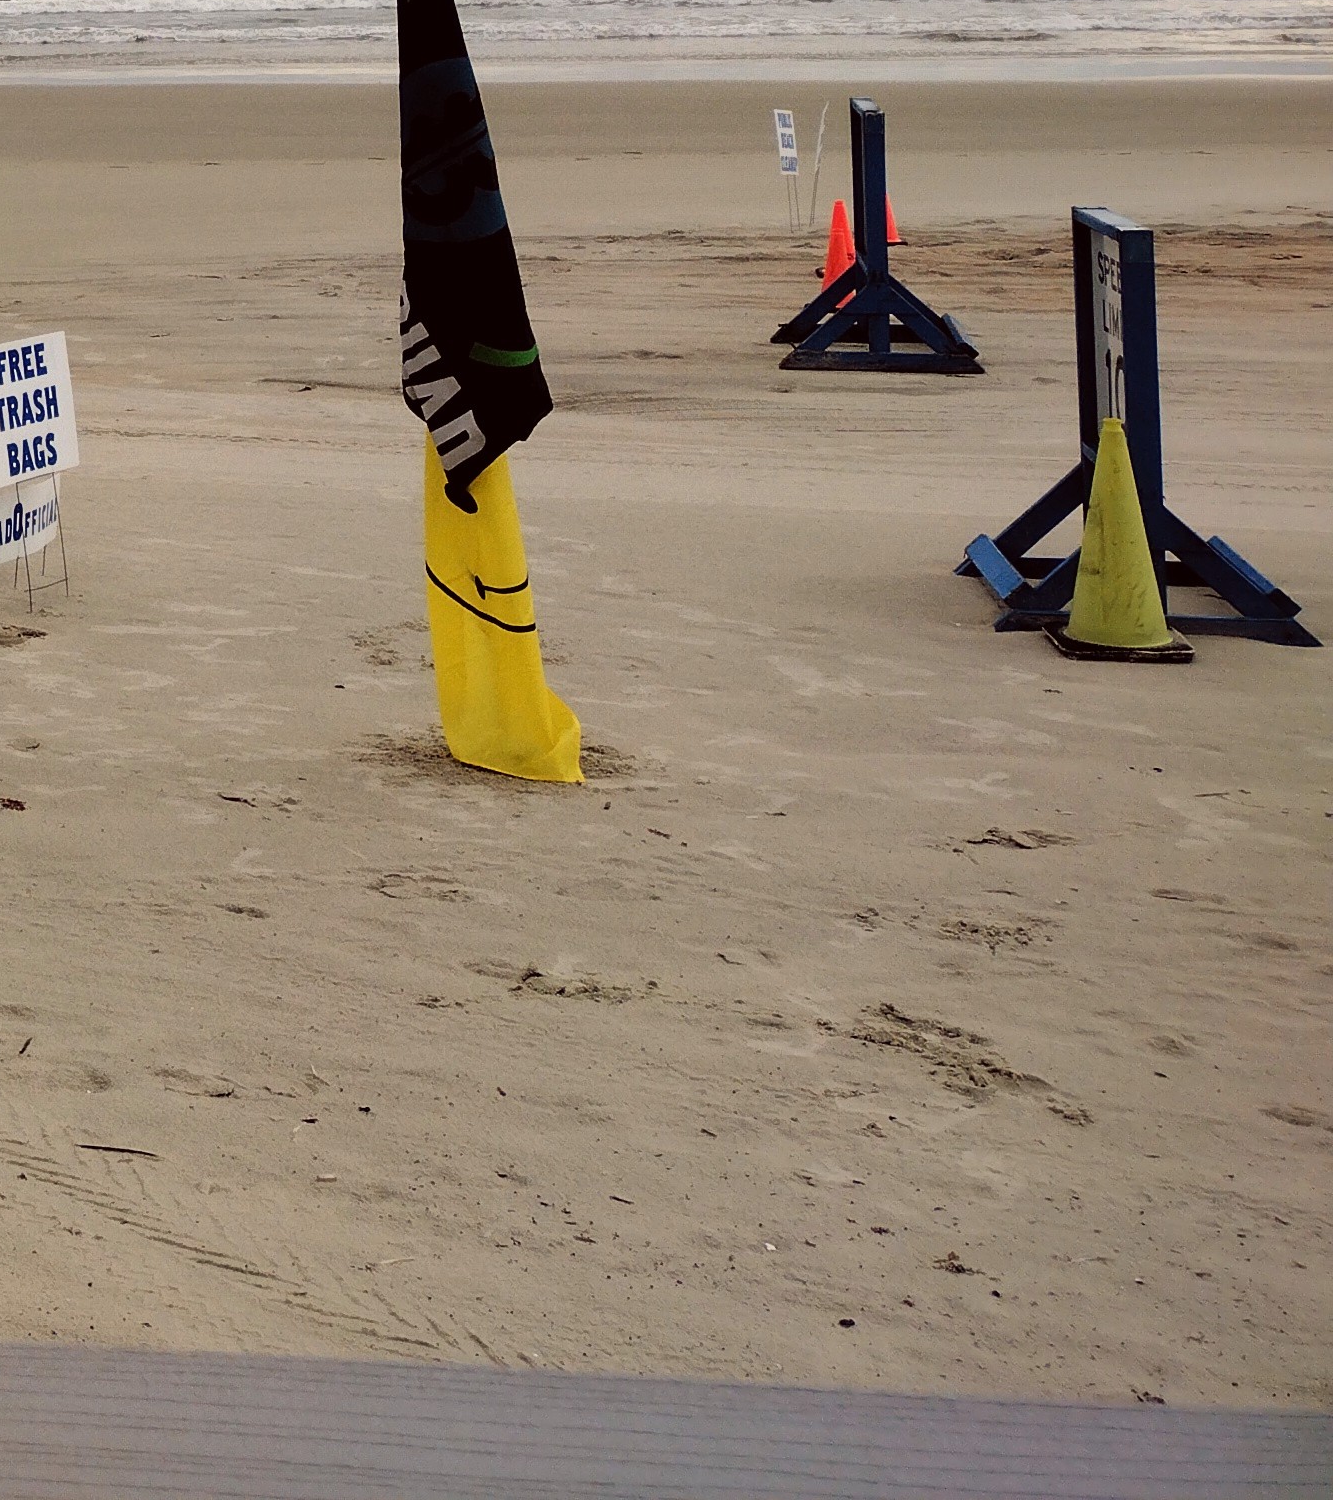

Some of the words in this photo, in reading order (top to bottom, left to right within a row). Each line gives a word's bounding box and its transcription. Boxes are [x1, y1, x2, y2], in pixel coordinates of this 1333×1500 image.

[1097, 251, 1121, 294] SPEE
[1103, 299, 1122, 341] LIM
[7, 433, 58, 477] BAGS
